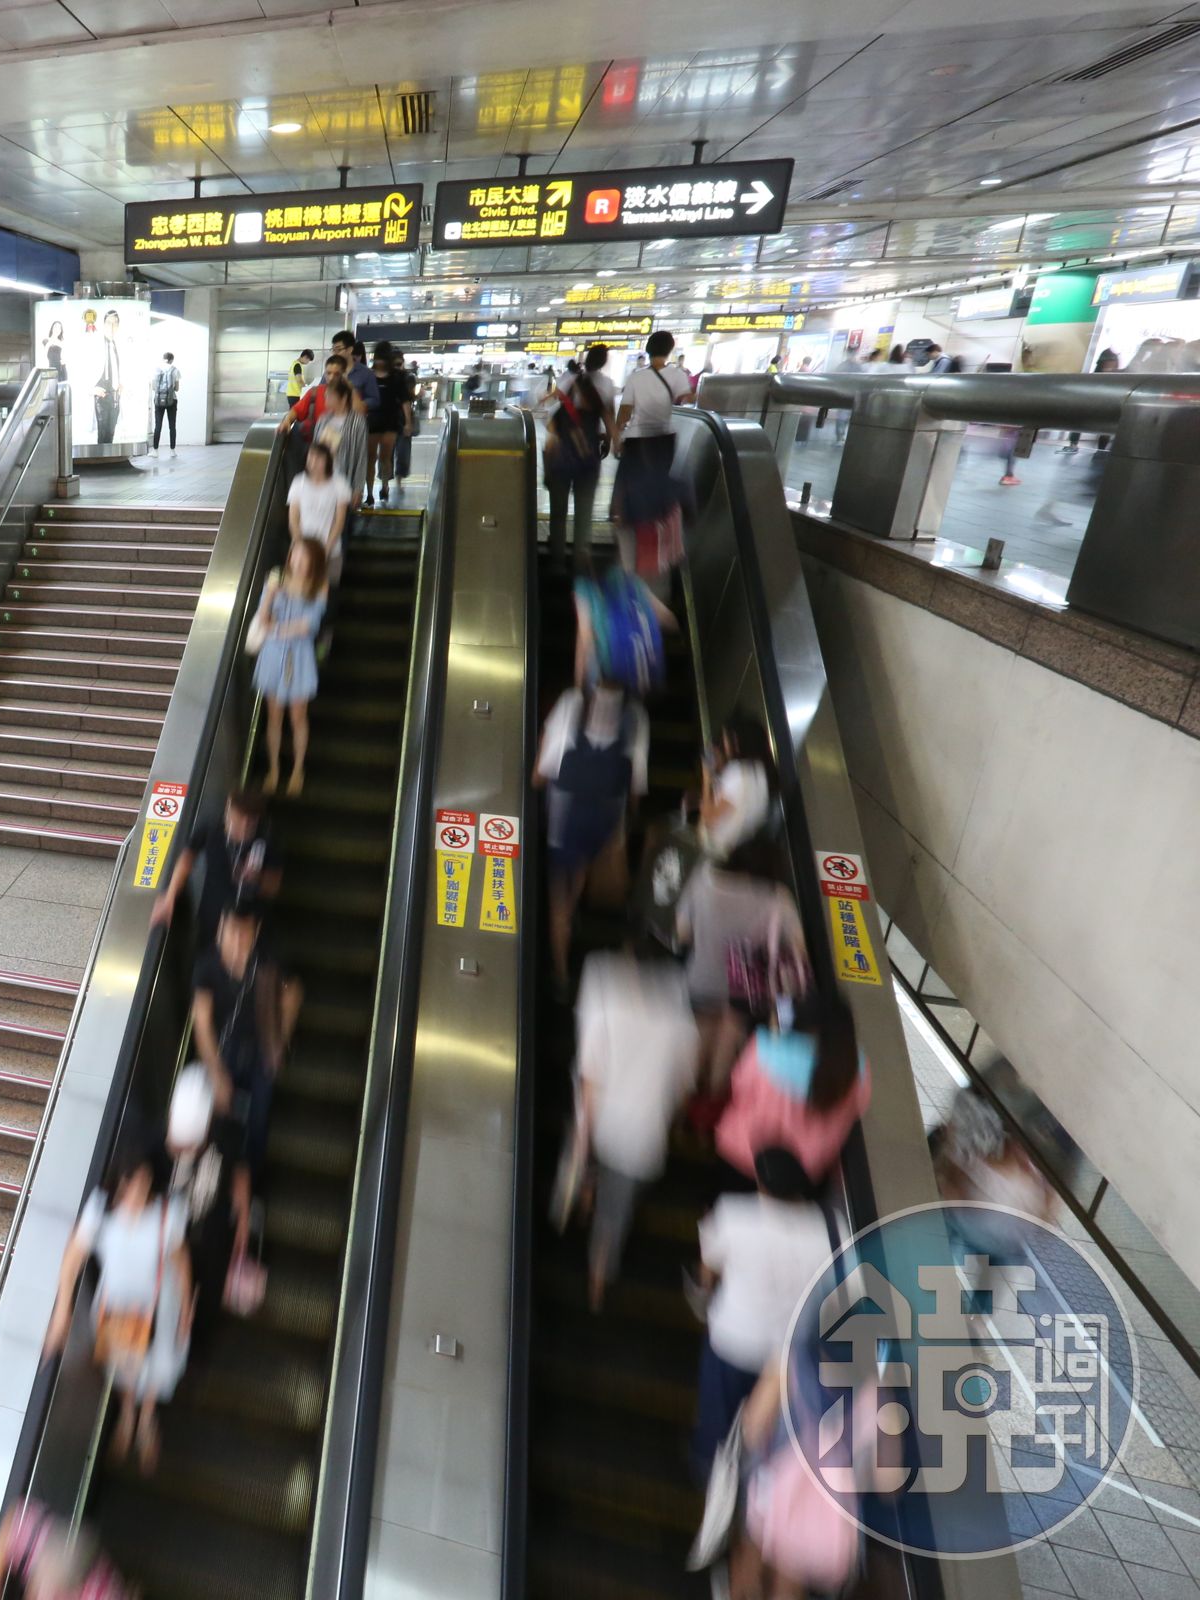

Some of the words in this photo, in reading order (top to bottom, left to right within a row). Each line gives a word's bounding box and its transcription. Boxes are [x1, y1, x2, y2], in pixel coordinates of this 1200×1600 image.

[469, 185, 540, 207] 市民大道
[265, 202, 384, 229] 桃園機場捷運
[480, 206, 508, 218] Civic
[509, 204, 538, 216] Blvd.
[594, 199, 609, 215] R
[704, 206, 734, 220] Line
[150, 211, 224, 236] 忠孝西路
[134, 236, 188, 251] Zhongxiao
[189, 235, 203, 248] W.
[204, 233, 224, 246] Rd.
[264, 228, 311, 245] Taoyuan
[313, 227, 352, 242] Airport
[354, 224, 383, 238] MRT
